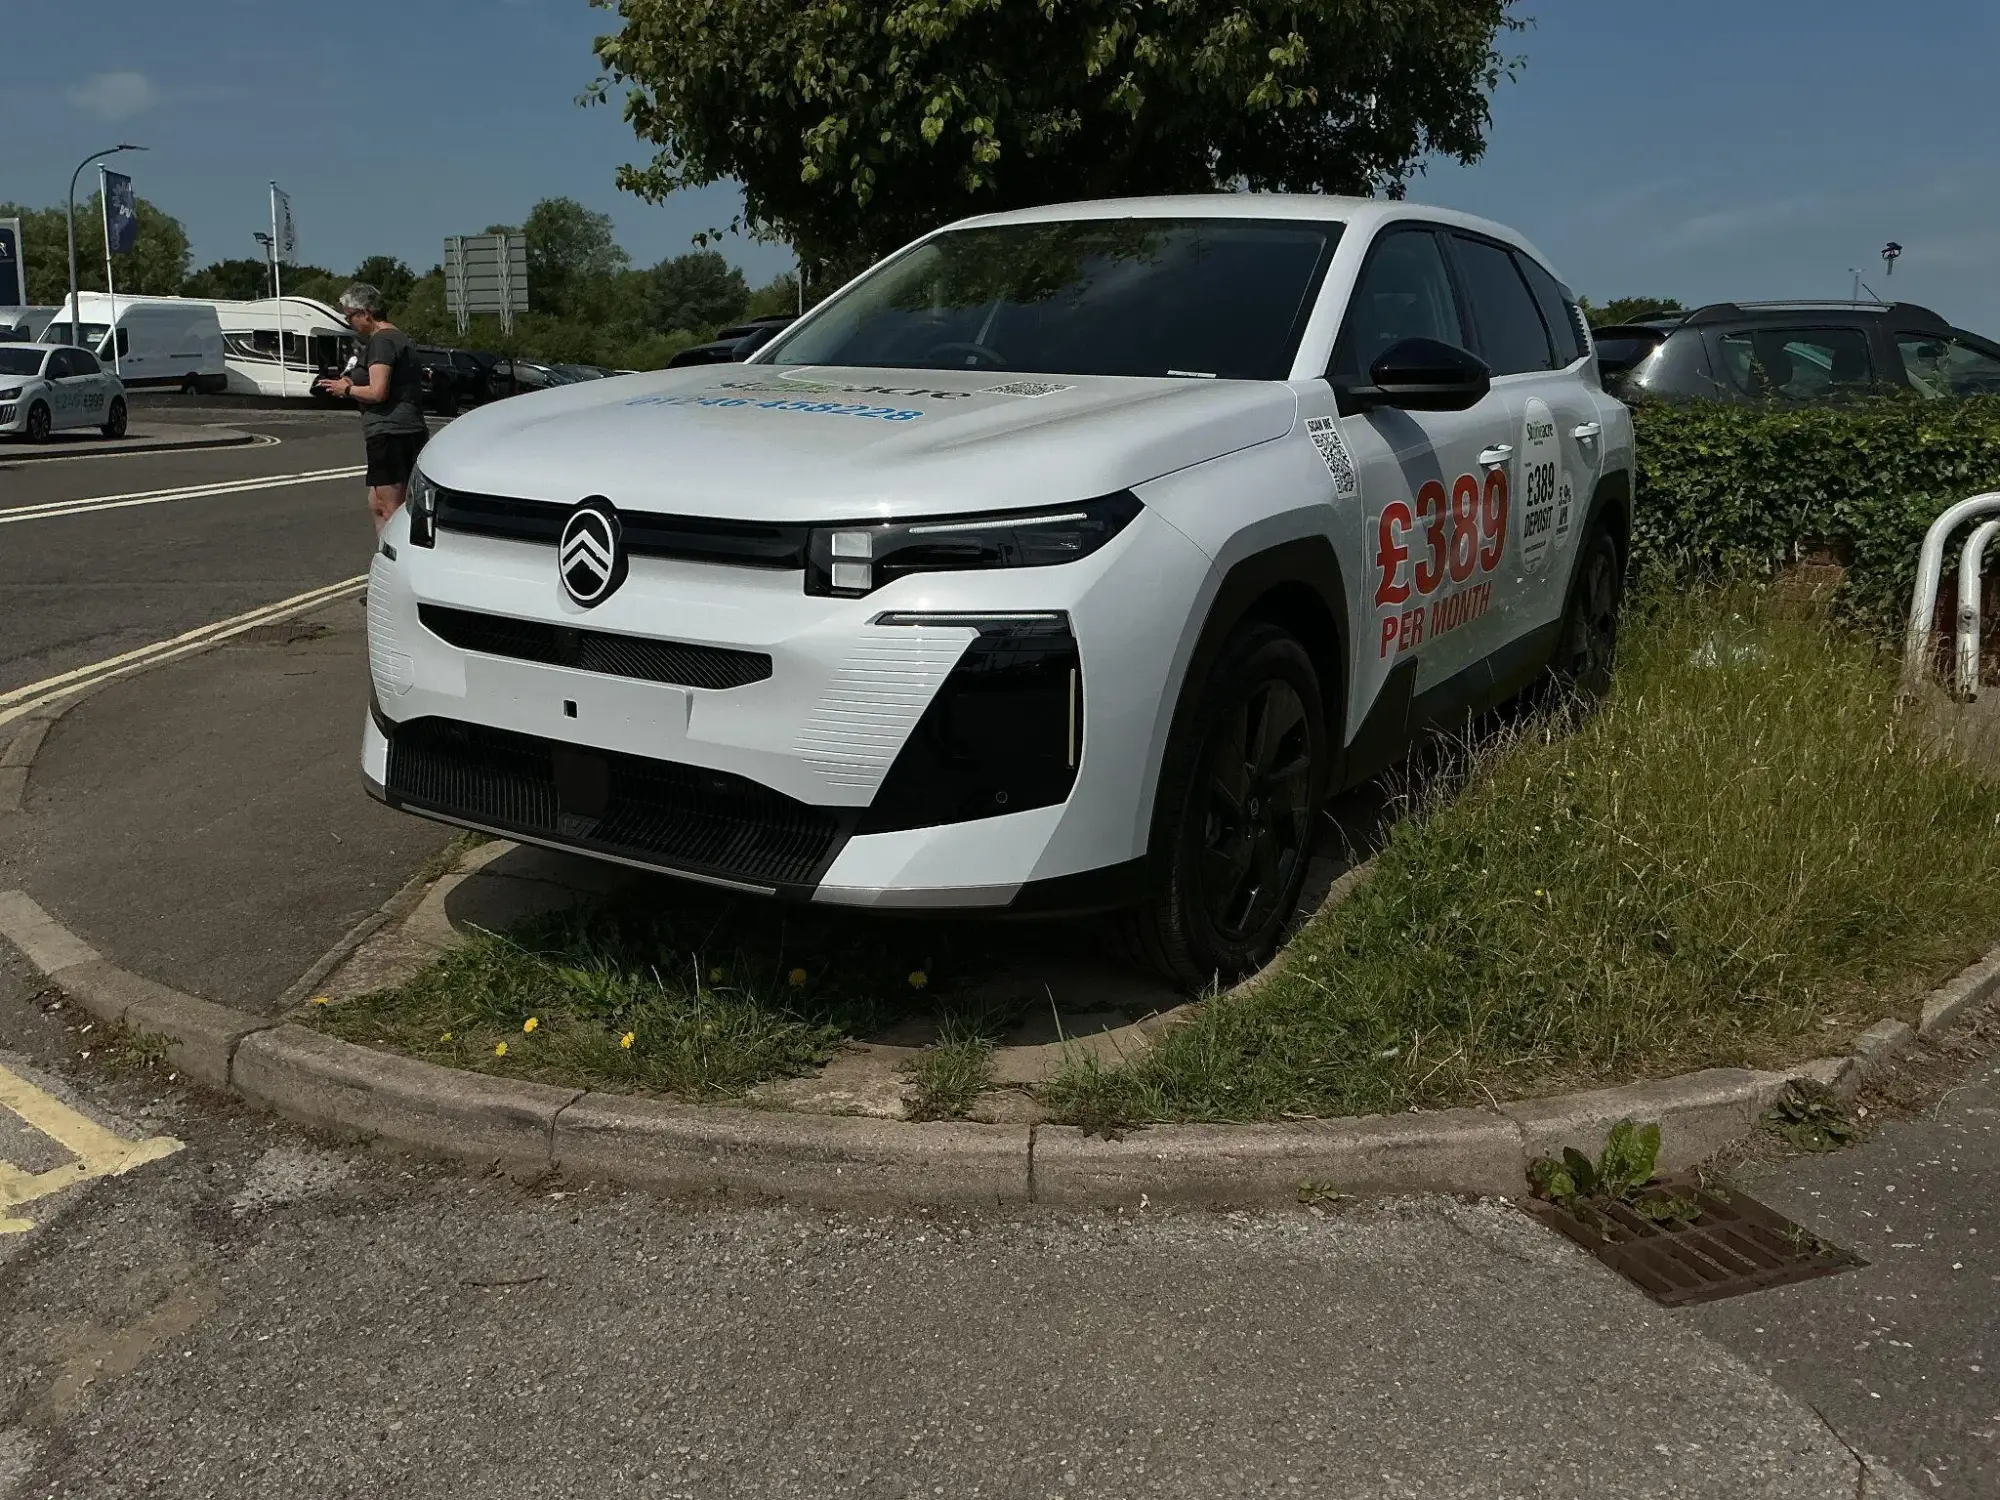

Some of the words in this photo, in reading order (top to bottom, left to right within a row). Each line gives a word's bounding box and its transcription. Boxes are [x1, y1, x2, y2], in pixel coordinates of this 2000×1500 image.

[756, 400, 925, 421] 458228
[1307, 419, 1323, 432] SCAN
[1322, 418, 1333, 430] ME
[1526, 461, 1555, 507] £389
[1375, 469, 1509, 609] £389
[1524, 506, 1554, 539] DEPOSIT
[1380, 606, 1426, 660] PER
[1430, 580, 1493, 638] MONTH
